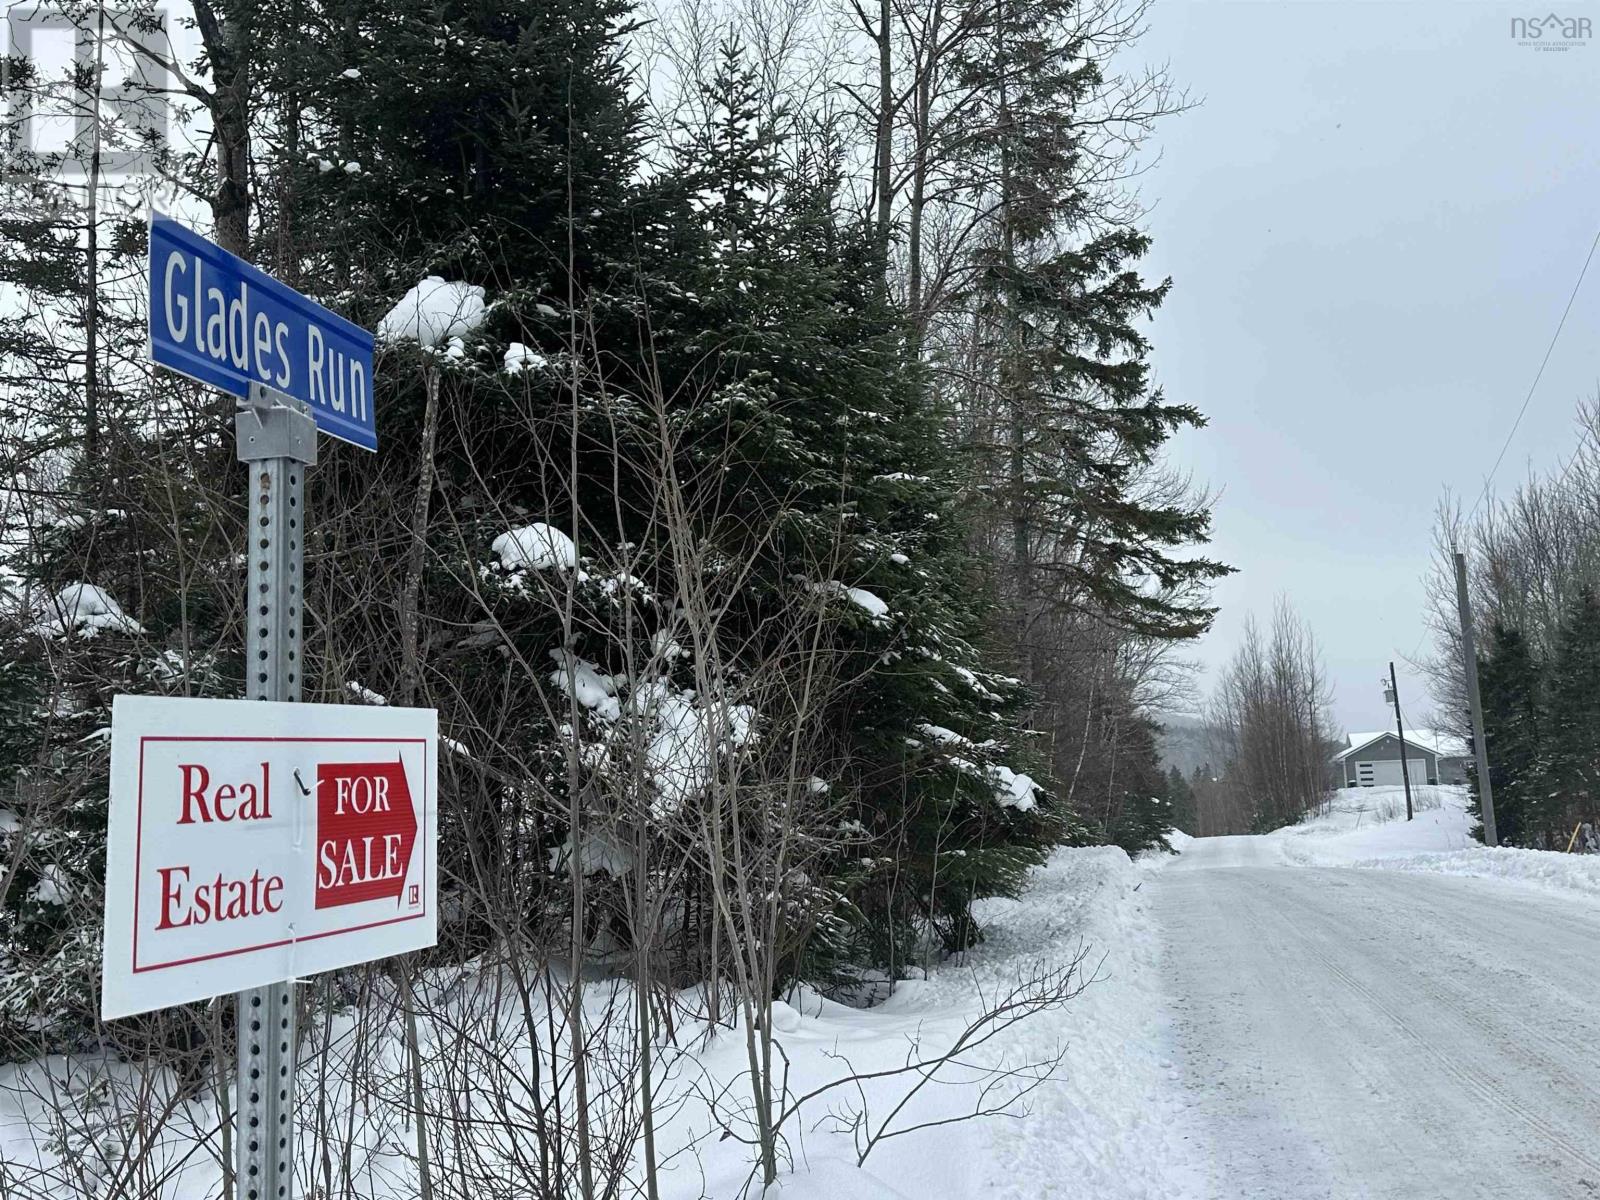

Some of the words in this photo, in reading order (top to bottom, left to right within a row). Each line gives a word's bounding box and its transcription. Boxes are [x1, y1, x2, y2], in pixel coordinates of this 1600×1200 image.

[164, 251, 290, 389] Glades
[308, 324, 366, 422] Run
[176, 761, 272, 825] Real
[334, 775, 390, 815] FOR
[318, 833, 403, 889] SALE
[155, 865, 284, 930] Estate
